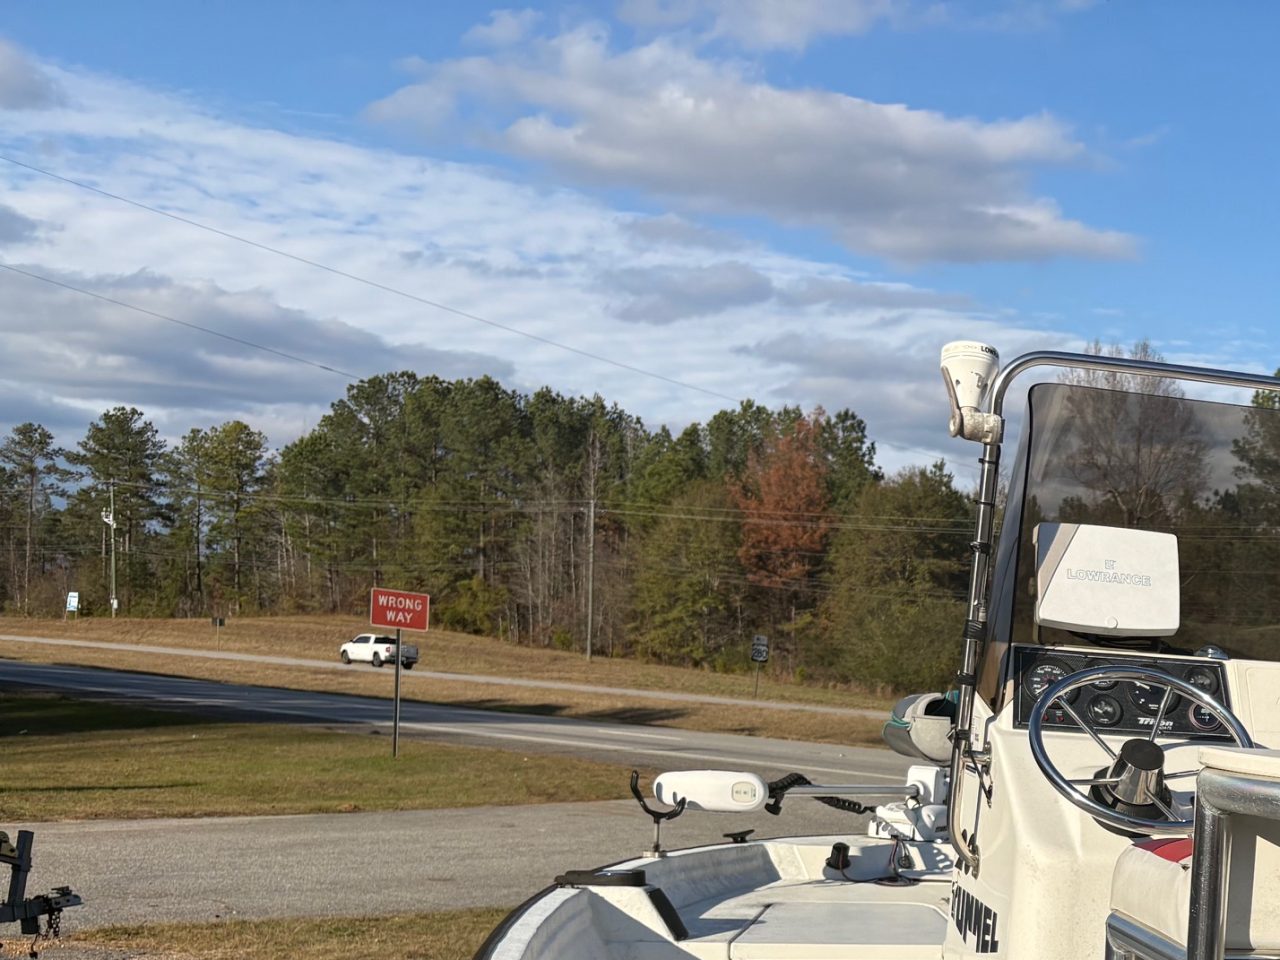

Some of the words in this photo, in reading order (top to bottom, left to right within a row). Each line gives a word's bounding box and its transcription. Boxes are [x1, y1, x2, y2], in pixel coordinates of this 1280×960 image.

[1067, 569, 1151, 586] LOWRANCE
[378, 595, 422, 611] WRONG
[386, 610, 413, 623] WAY
